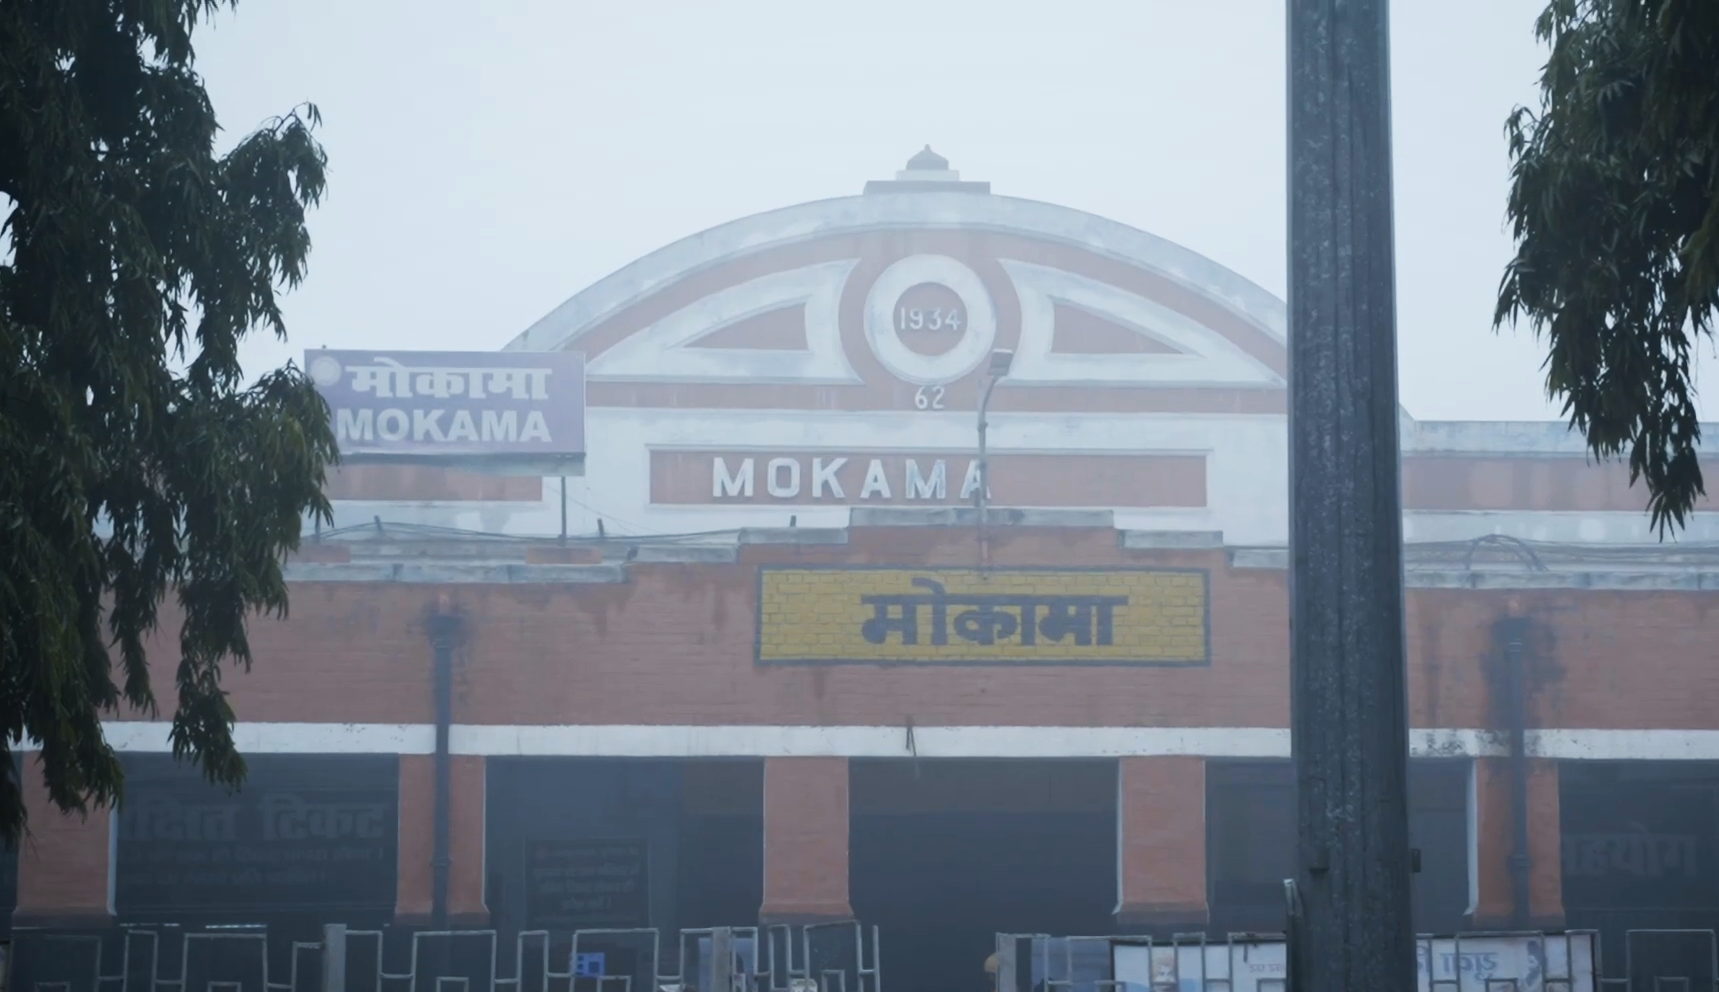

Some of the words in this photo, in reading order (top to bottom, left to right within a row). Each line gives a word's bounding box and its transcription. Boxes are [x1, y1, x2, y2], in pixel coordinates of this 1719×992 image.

[899, 307, 962, 331] 1934
[346, 357, 552, 399] मोकामा
[914, 386, 945, 410] 62
[337, 408, 552, 442] MOKAMA
[712, 456, 991, 499] MOKAMA
[860, 577, 1129, 646] मोकामा
[257, 792, 390, 840] टिकट
